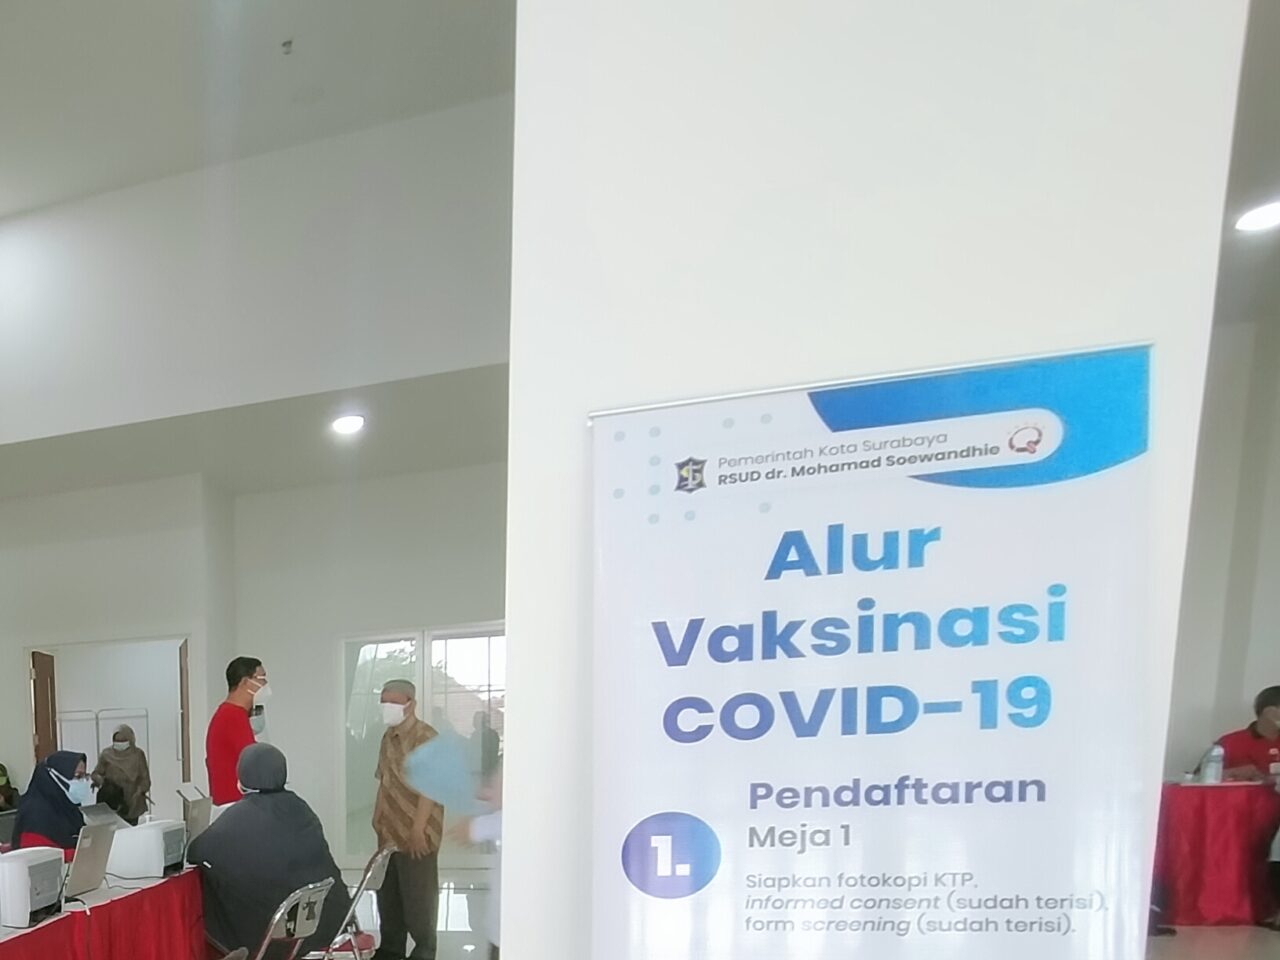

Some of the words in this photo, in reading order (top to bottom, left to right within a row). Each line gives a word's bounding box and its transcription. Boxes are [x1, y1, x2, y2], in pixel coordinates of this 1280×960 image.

[717, 466, 762, 486] RSUD
[764, 462, 788, 481] dr.
[790, 454, 882, 480] Mohamad
[885, 442, 1001, 470] Soewandhie
[718, 443, 815, 469] Pemerintah
[818, 438, 859, 459] Kota
[862, 431, 949, 454] Surabaya
[764, 523, 942, 581] Alur
[651, 583, 1067, 668] Vaksinasi
[662, 675, 1053, 744] COVID-19
[748, 775, 1047, 811] Pendaftaran
[650, 835, 691, 877] 1.
[747, 825, 832, 854] Meja
[840, 823, 852, 847] 1
[745, 872, 832, 891] Siapkan
[836, 871, 929, 892] fotokopi
[744, 893, 844, 913] informed
[849, 894, 941, 911] consent
[946, 889, 1030, 913] (sudah
[744, 915, 796, 932] form
[801, 914, 911, 937] screening
[916, 912, 1000, 936] (sudah
[1004, 911, 1077, 936] terisi).
